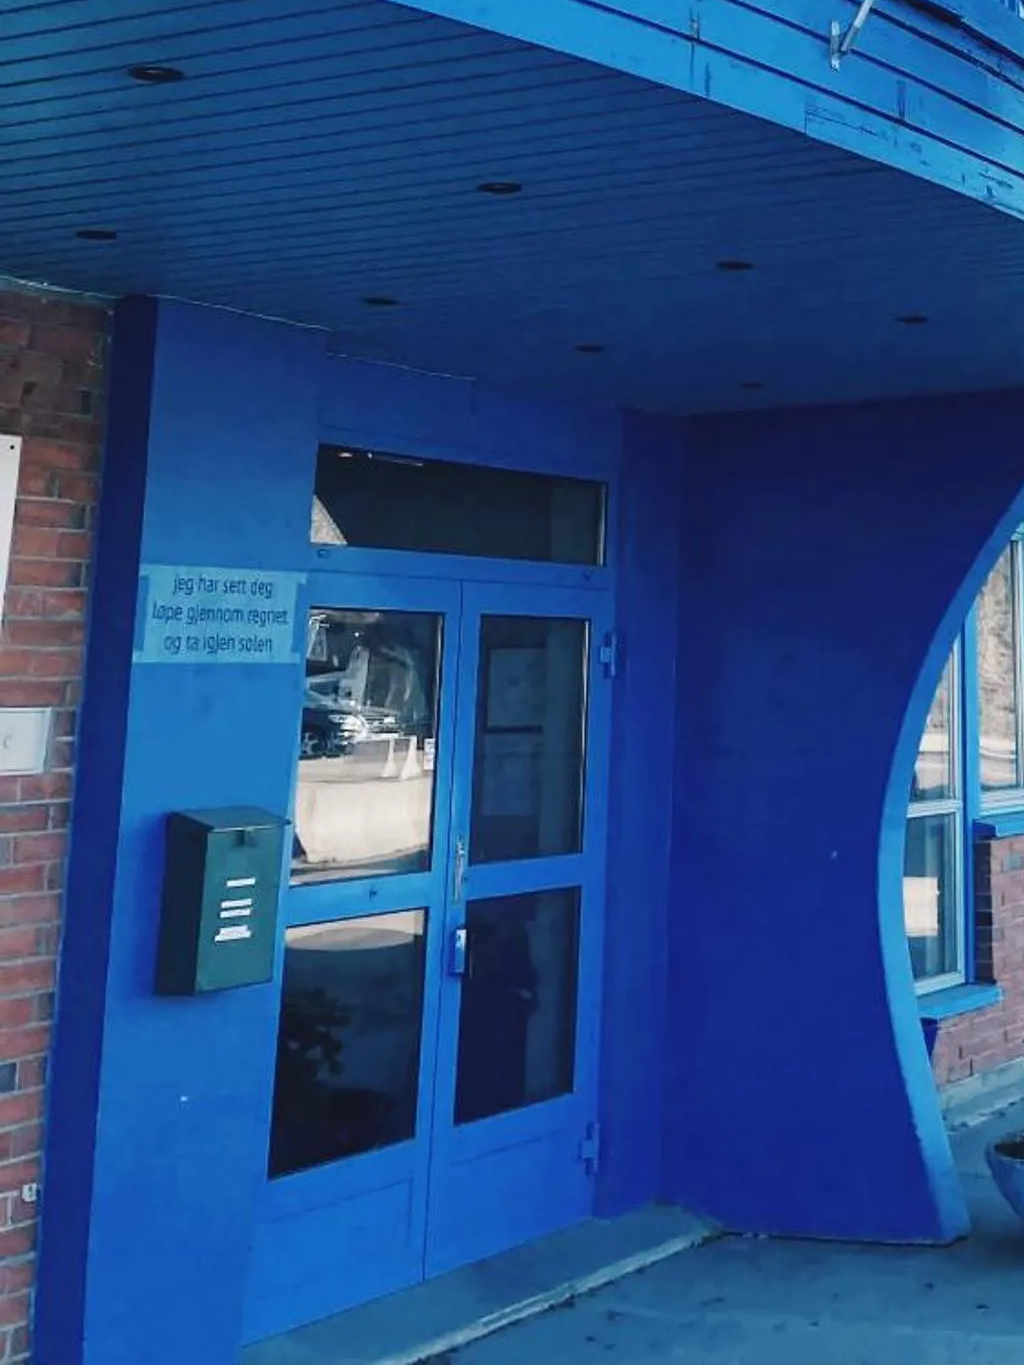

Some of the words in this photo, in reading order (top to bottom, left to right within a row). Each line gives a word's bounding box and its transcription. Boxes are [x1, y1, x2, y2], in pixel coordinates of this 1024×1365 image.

[173, 574, 194, 596] jeg
[198, 574, 221, 594] har
[223, 578, 246, 595] sett
[250, 579, 273, 600] deg
[185, 603, 243, 626] gjennom
[247, 609, 288, 628] regnet
[164, 635, 181, 655] og
[186, 634, 200, 652] ta
[238, 634, 273, 653] solen
